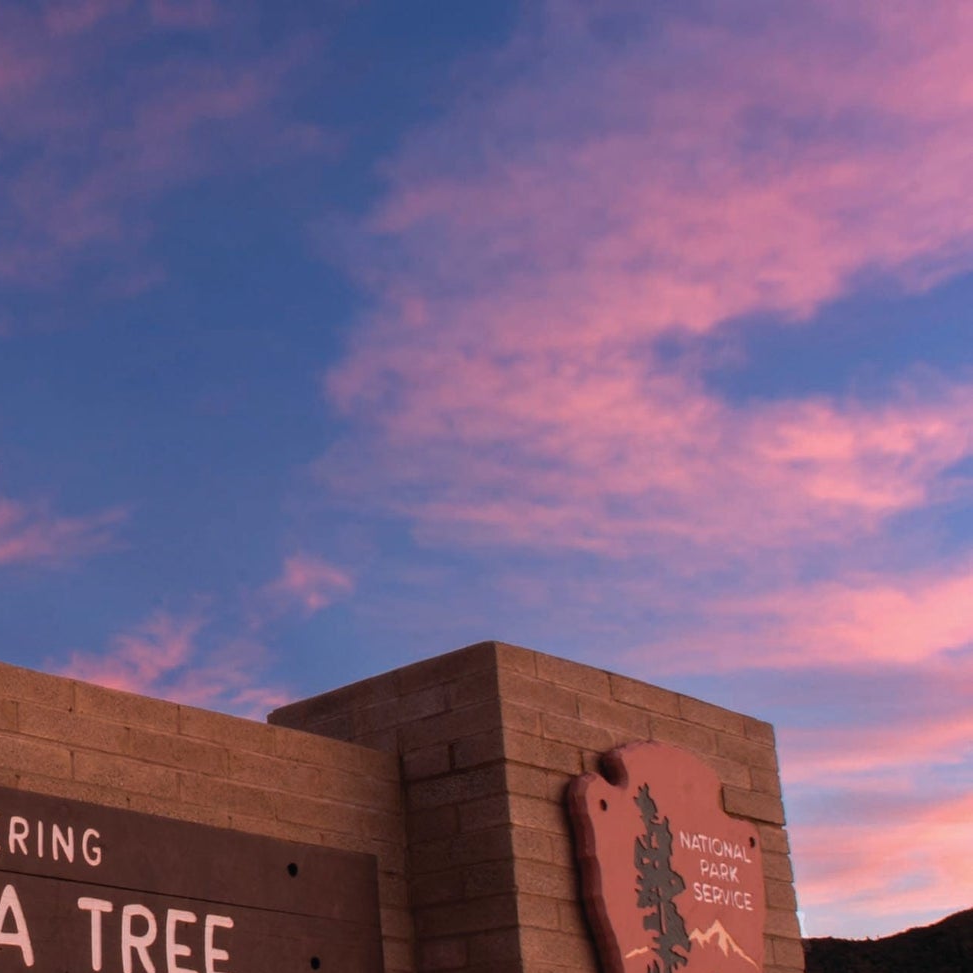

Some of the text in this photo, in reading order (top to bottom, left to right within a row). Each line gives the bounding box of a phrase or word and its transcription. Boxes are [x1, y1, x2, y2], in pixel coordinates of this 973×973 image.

[679, 830, 752, 864] NATIONAL
[700, 859, 740, 884] PARK
[693, 882, 754, 911] SERVICE
